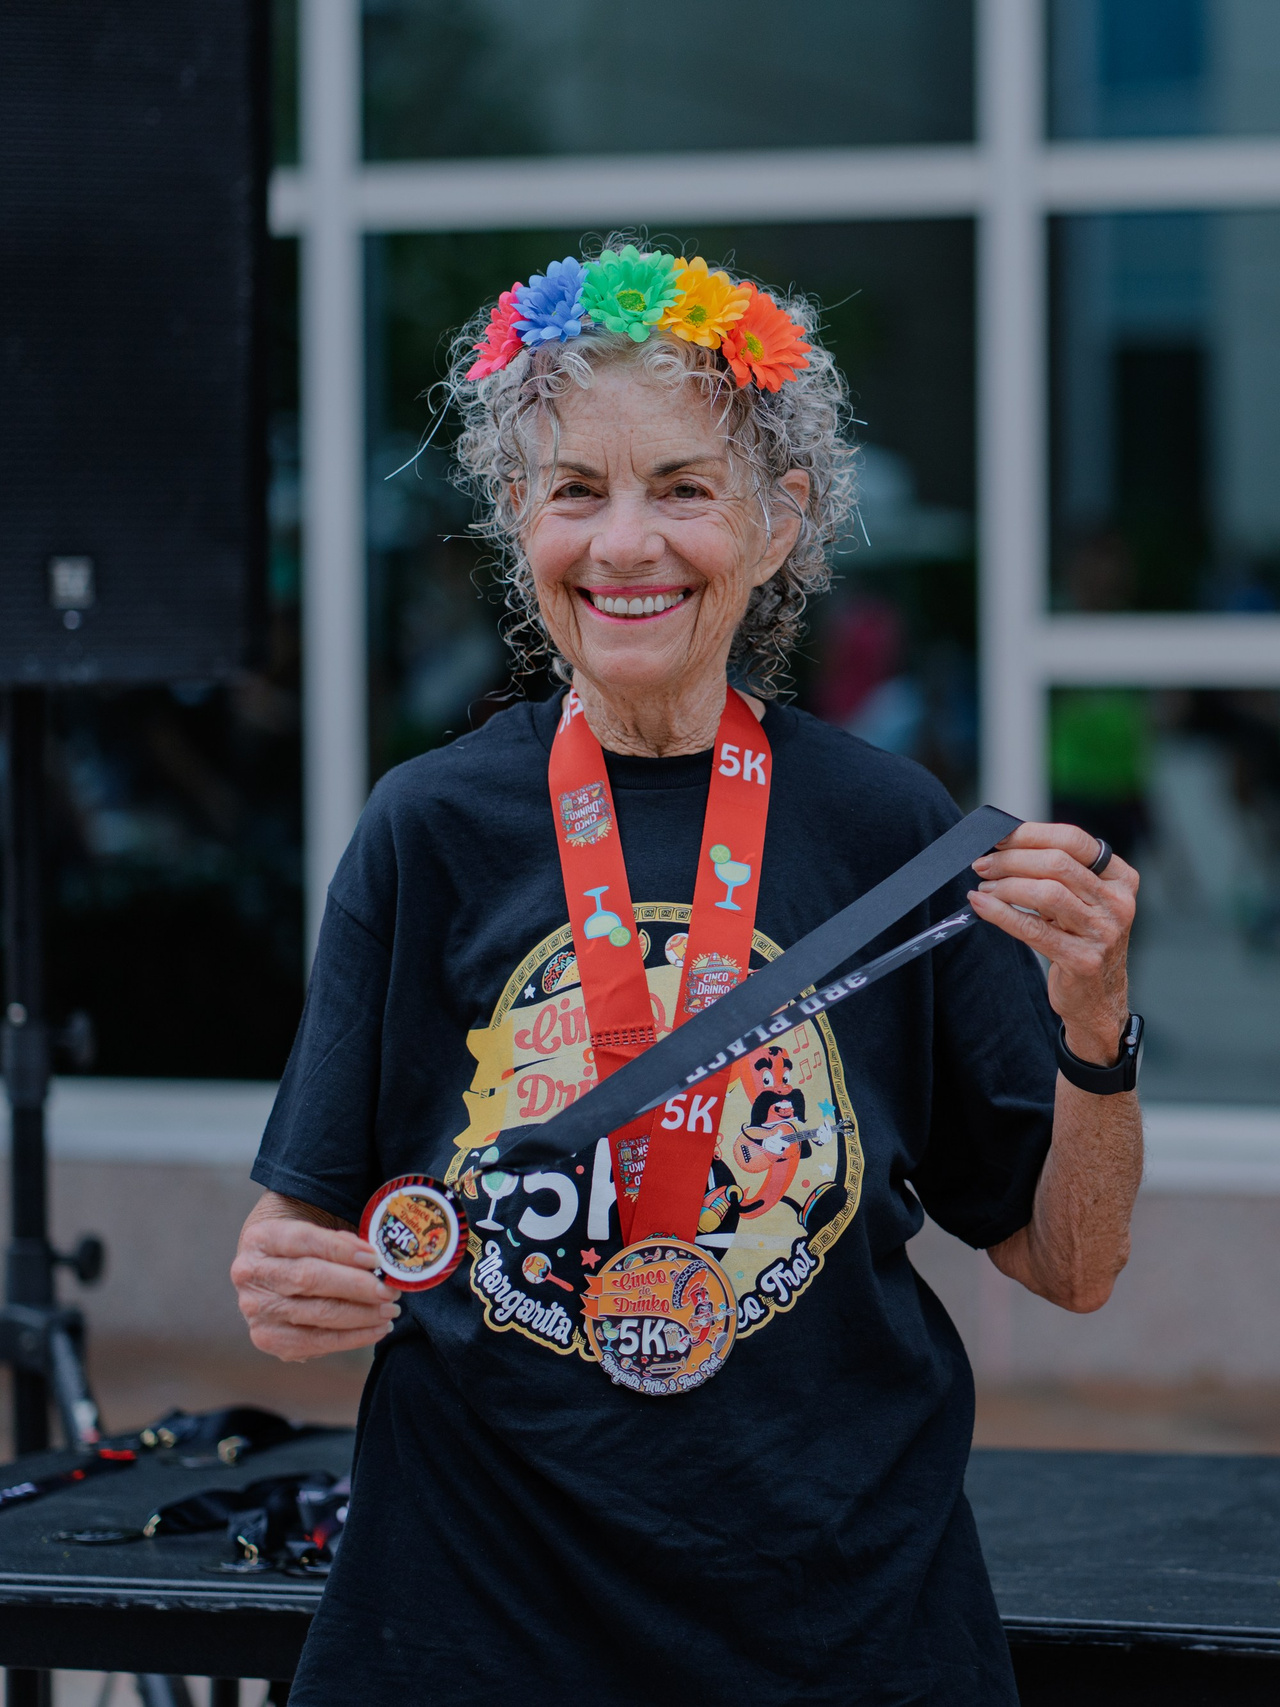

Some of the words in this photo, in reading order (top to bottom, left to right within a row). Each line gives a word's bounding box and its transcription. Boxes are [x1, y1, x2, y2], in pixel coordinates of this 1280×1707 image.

[718, 742, 766, 785] 5K
[577, 793, 589, 804] 5K
[570, 800, 599, 820] DRINKO
[574, 813, 597, 831] CINCO
[697, 981, 730, 995] DRINKO
[703, 972, 729, 983] CINCO
[798, 971, 870, 1015] 3RD
[660, 1094, 717, 1133] 5K
[387, 1220, 415, 1250] 5K
[612, 1269, 668, 1291] Cinco
[760, 1241, 816, 1302] Trot
[477, 1240, 572, 1344] Margarita
[613, 1294, 671, 1313] Drinko
[618, 1318, 666, 1355] 5K
[642, 1379, 667, 1393] Mile
